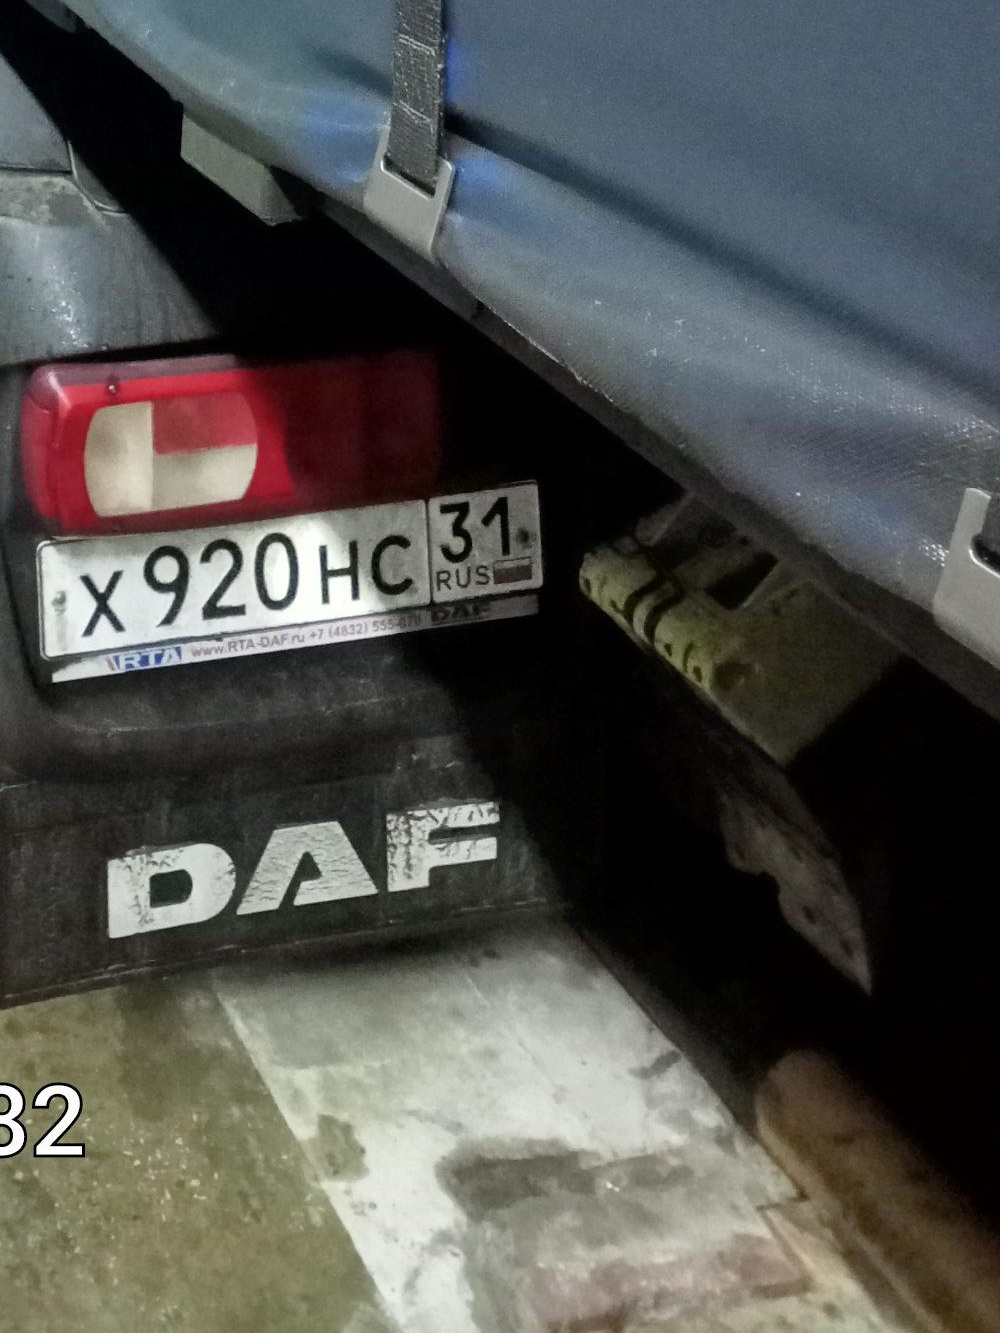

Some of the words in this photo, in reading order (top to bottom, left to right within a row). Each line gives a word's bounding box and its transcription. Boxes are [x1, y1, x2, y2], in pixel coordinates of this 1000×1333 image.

[439, 496, 513, 563] 31
[435, 564, 490, 592] RUS
[309, 629, 324, 641] +7
[107, 800, 500, 939] DAF
